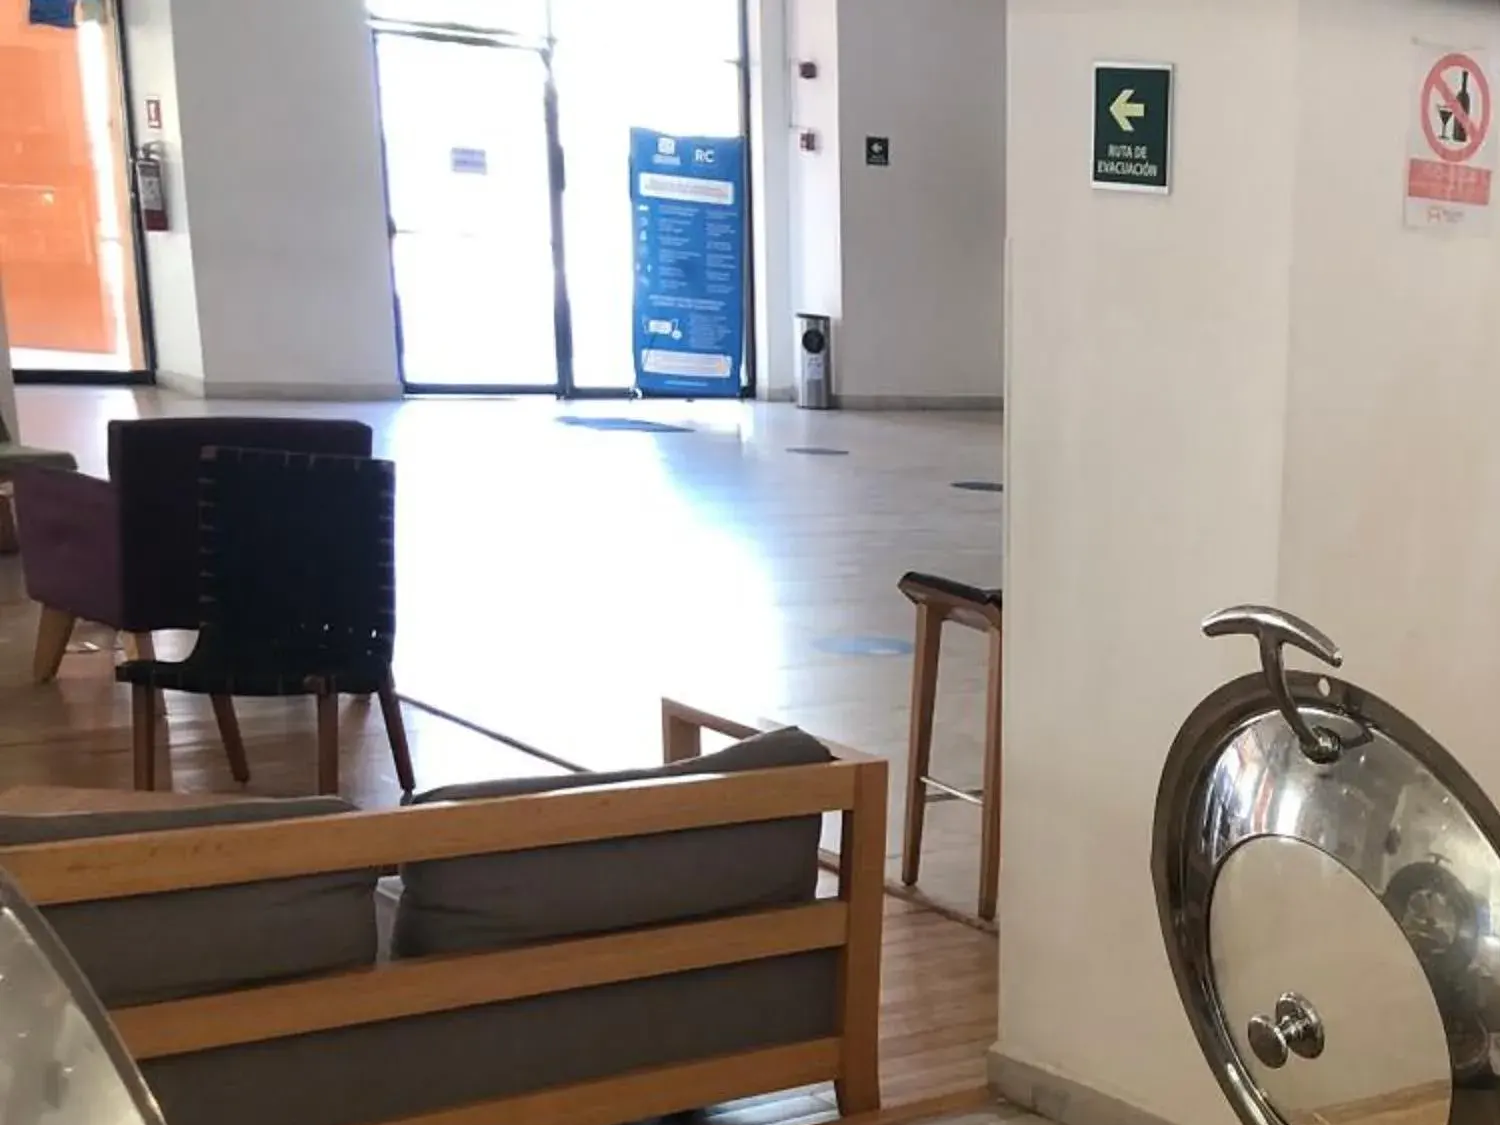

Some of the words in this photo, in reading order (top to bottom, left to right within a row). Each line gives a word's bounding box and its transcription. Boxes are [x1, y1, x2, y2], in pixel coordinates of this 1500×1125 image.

[1108, 144, 1132, 158] RUTA
[1134, 145, 1147, 159] DE
[1098, 160, 1158, 176] EVACUACIÓN
